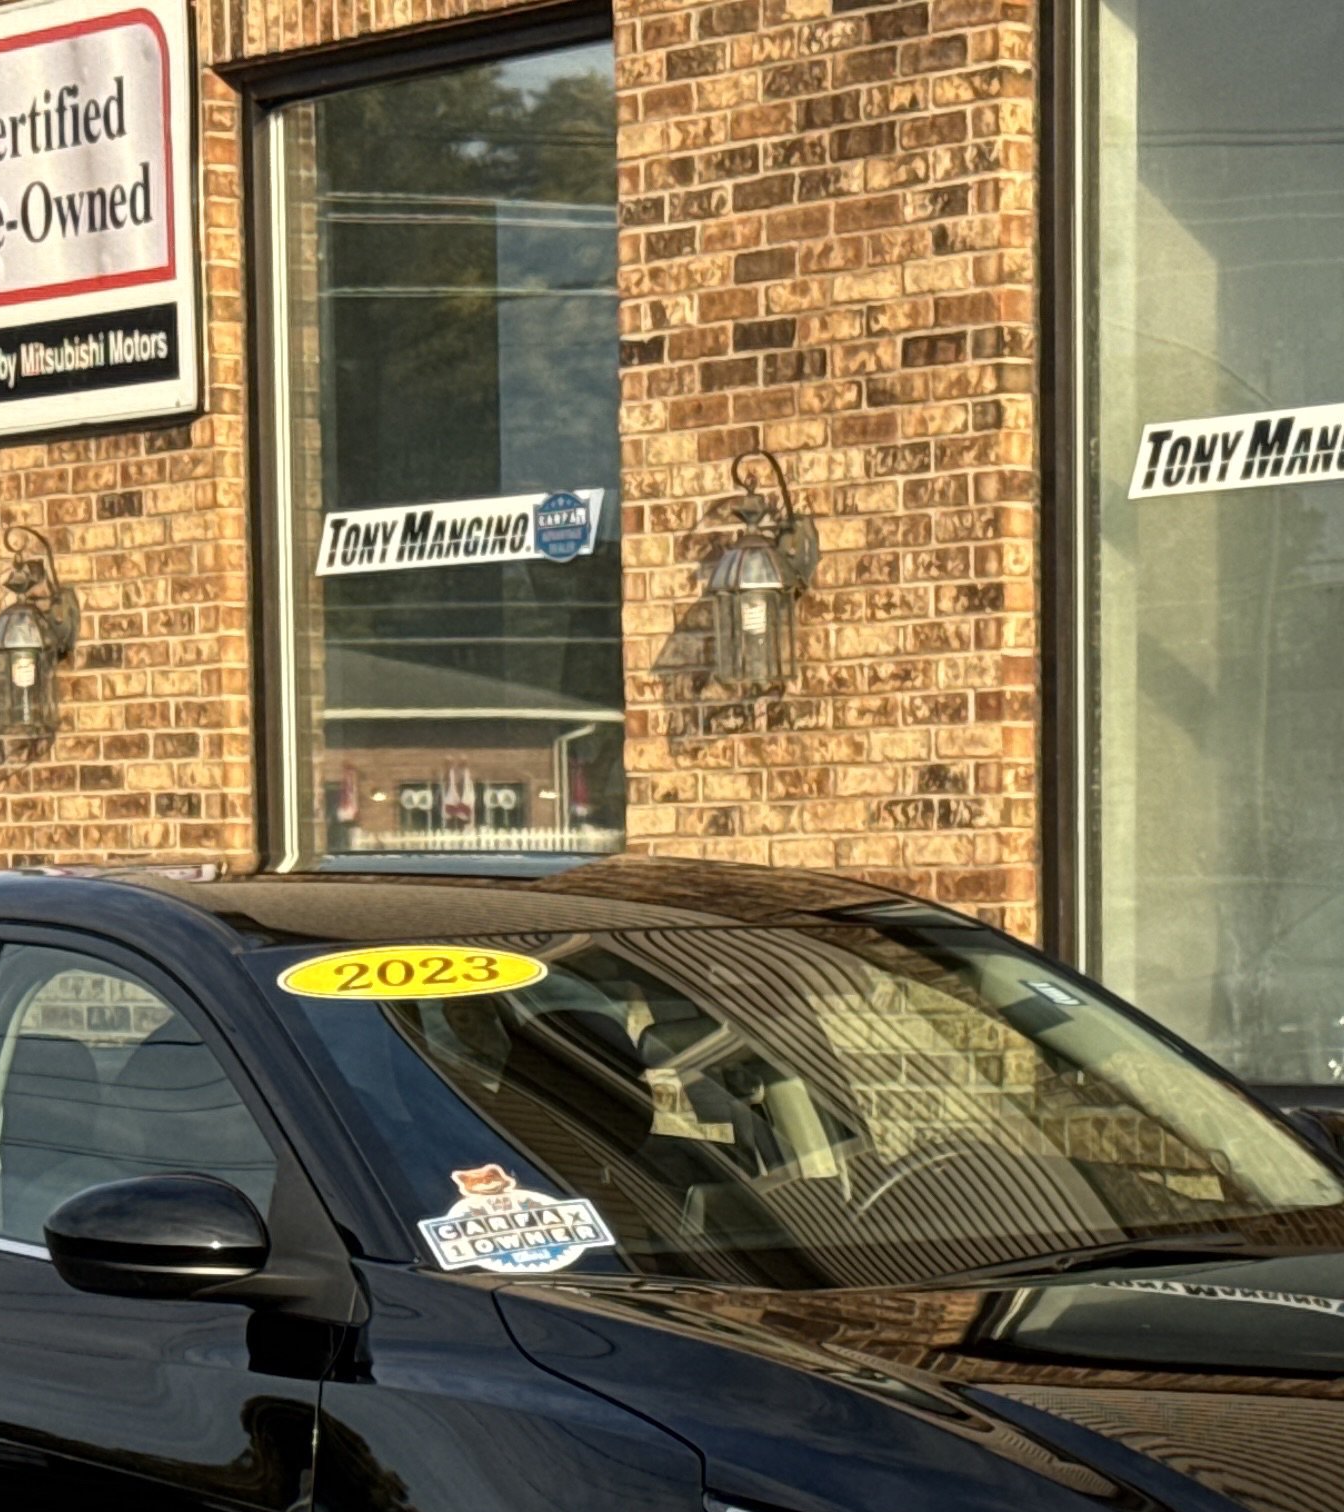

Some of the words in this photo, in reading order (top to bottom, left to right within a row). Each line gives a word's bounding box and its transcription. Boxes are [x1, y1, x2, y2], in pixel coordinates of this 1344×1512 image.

[21, 331, 105, 376] Mitsubishi
[109, 330, 168, 365] Motors
[1143, 430, 1245, 490] TONY
[327, 518, 397, 567] TONY
[334, 956, 501, 992] 2023
[438, 1209, 586, 1241] CARFAX
[450, 1245, 465, 1257] 1
[474, 1225, 598, 1255] OWNER
